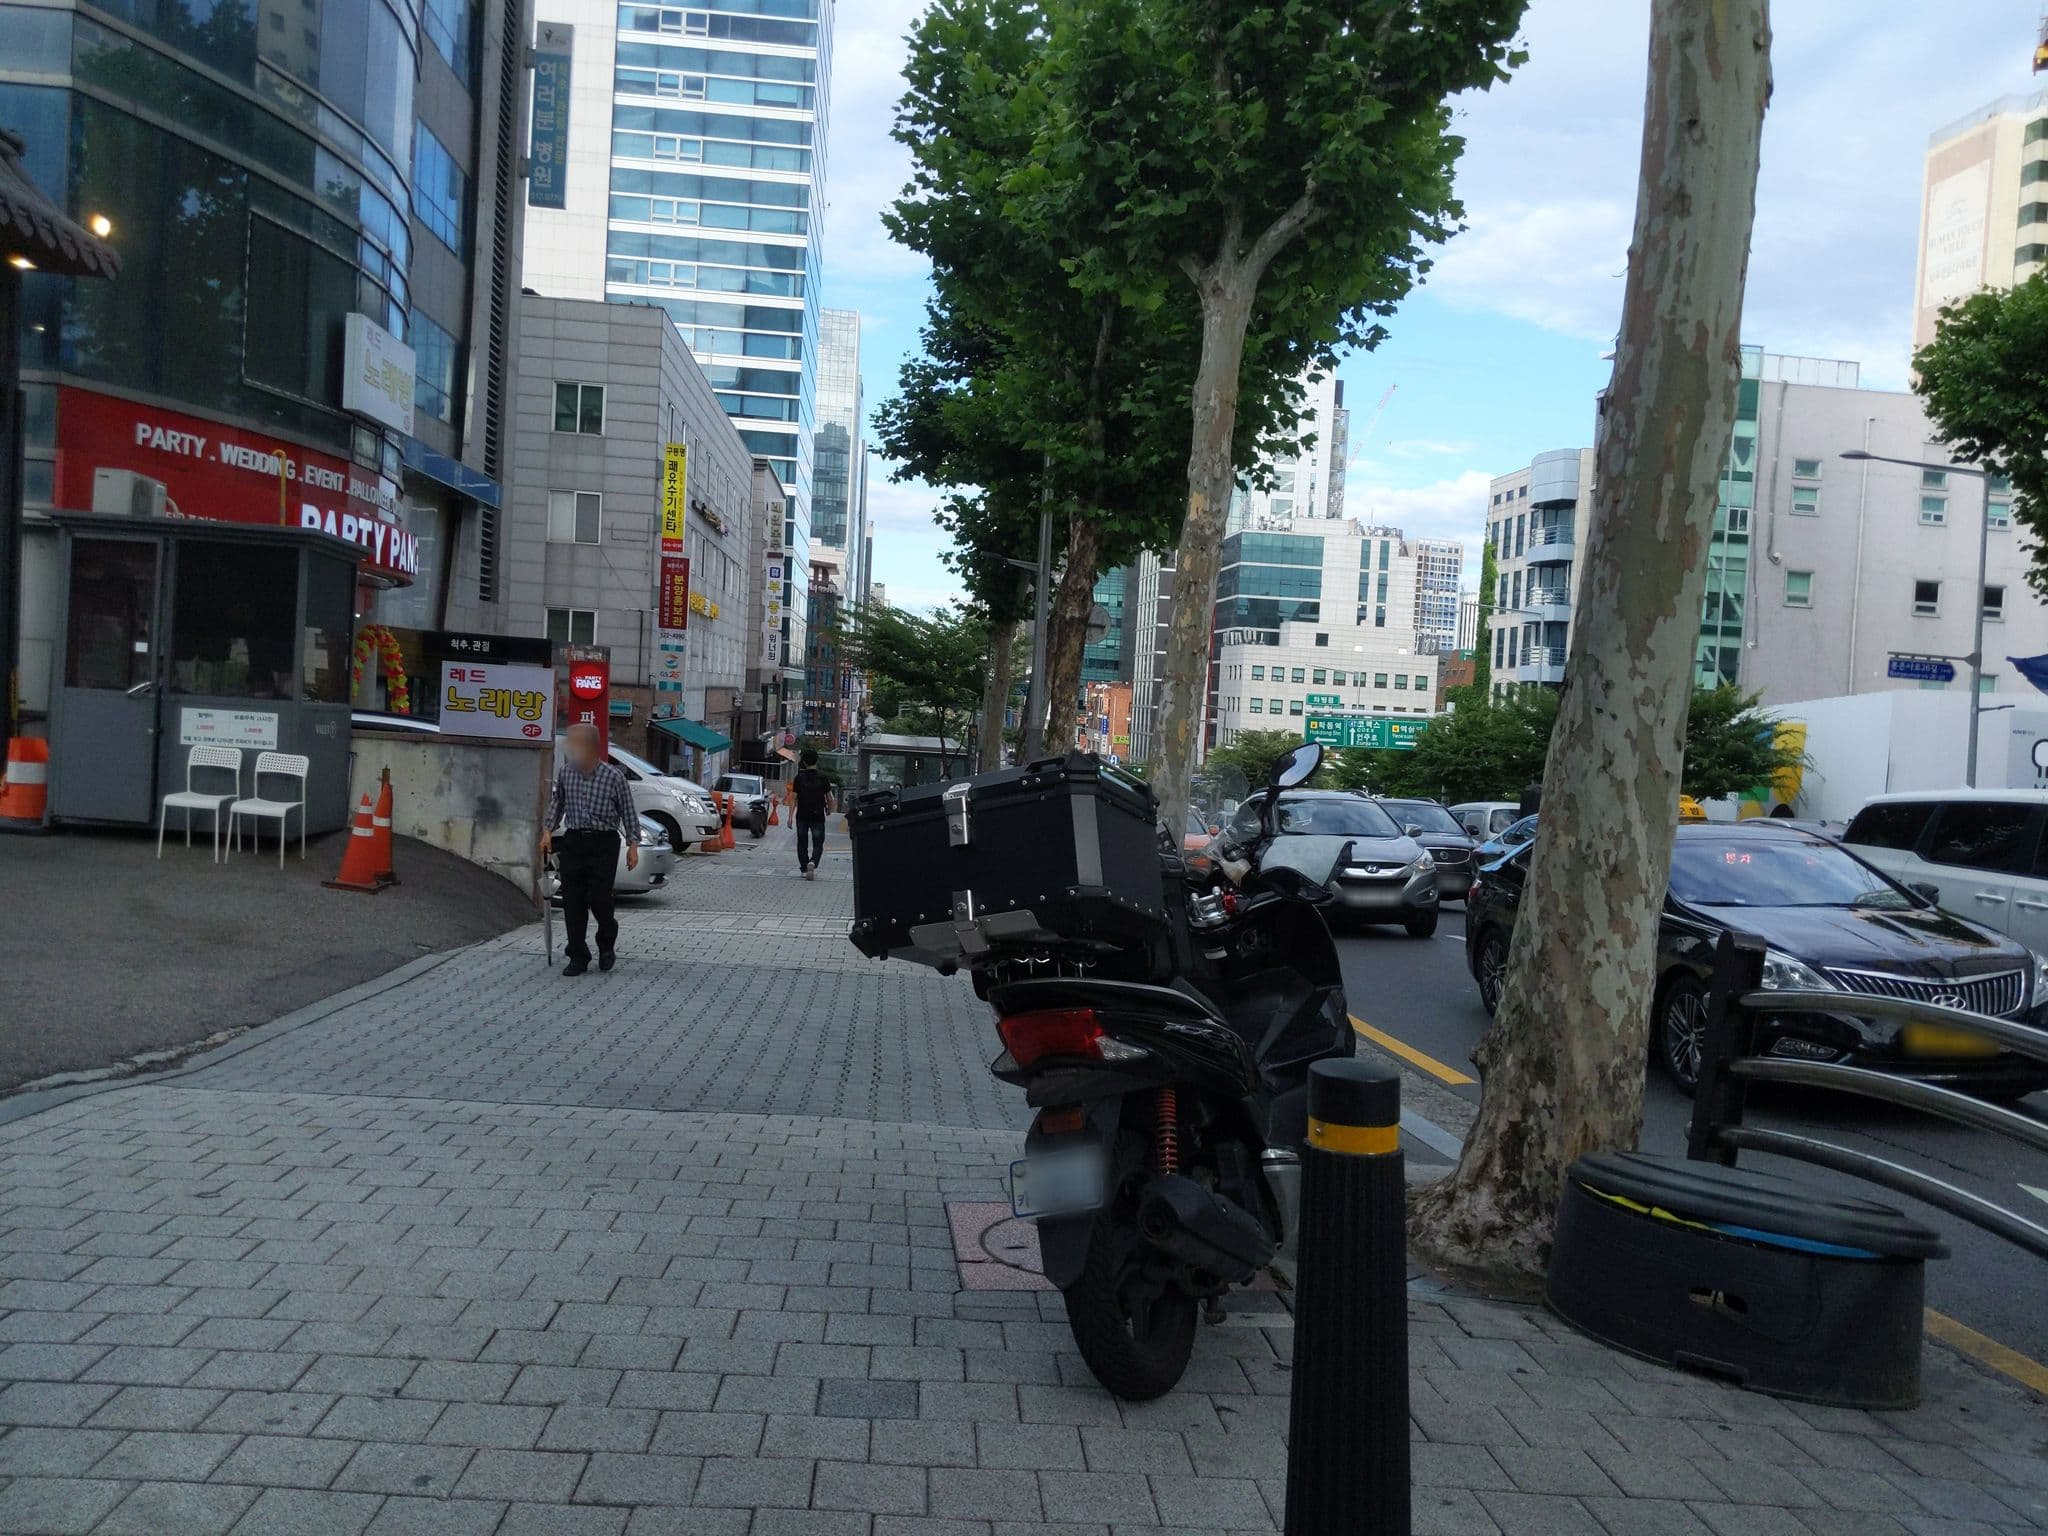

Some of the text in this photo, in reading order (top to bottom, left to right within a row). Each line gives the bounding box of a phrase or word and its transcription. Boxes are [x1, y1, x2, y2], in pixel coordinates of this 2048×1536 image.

[135, 422, 206, 458] PARTY
[220, 441, 295, 479] WEDDING
[304, 466, 346, 490] EVENT
[665, 460, 678, 533] 쾌유수기센타
[390, 526, 420, 576] PANG
[672, 573, 685, 627] 분양홍보관
[768, 580, 781, 628] 부동산
[450, 668, 486, 683] 레드
[445, 686, 547, 721] 노래방
[524, 726, 540, 736] 2F
[1319, 721, 1342, 730] 학동역
[1356, 733, 1378, 742] 언주로
[1357, 720, 1381, 729] 코엑스
